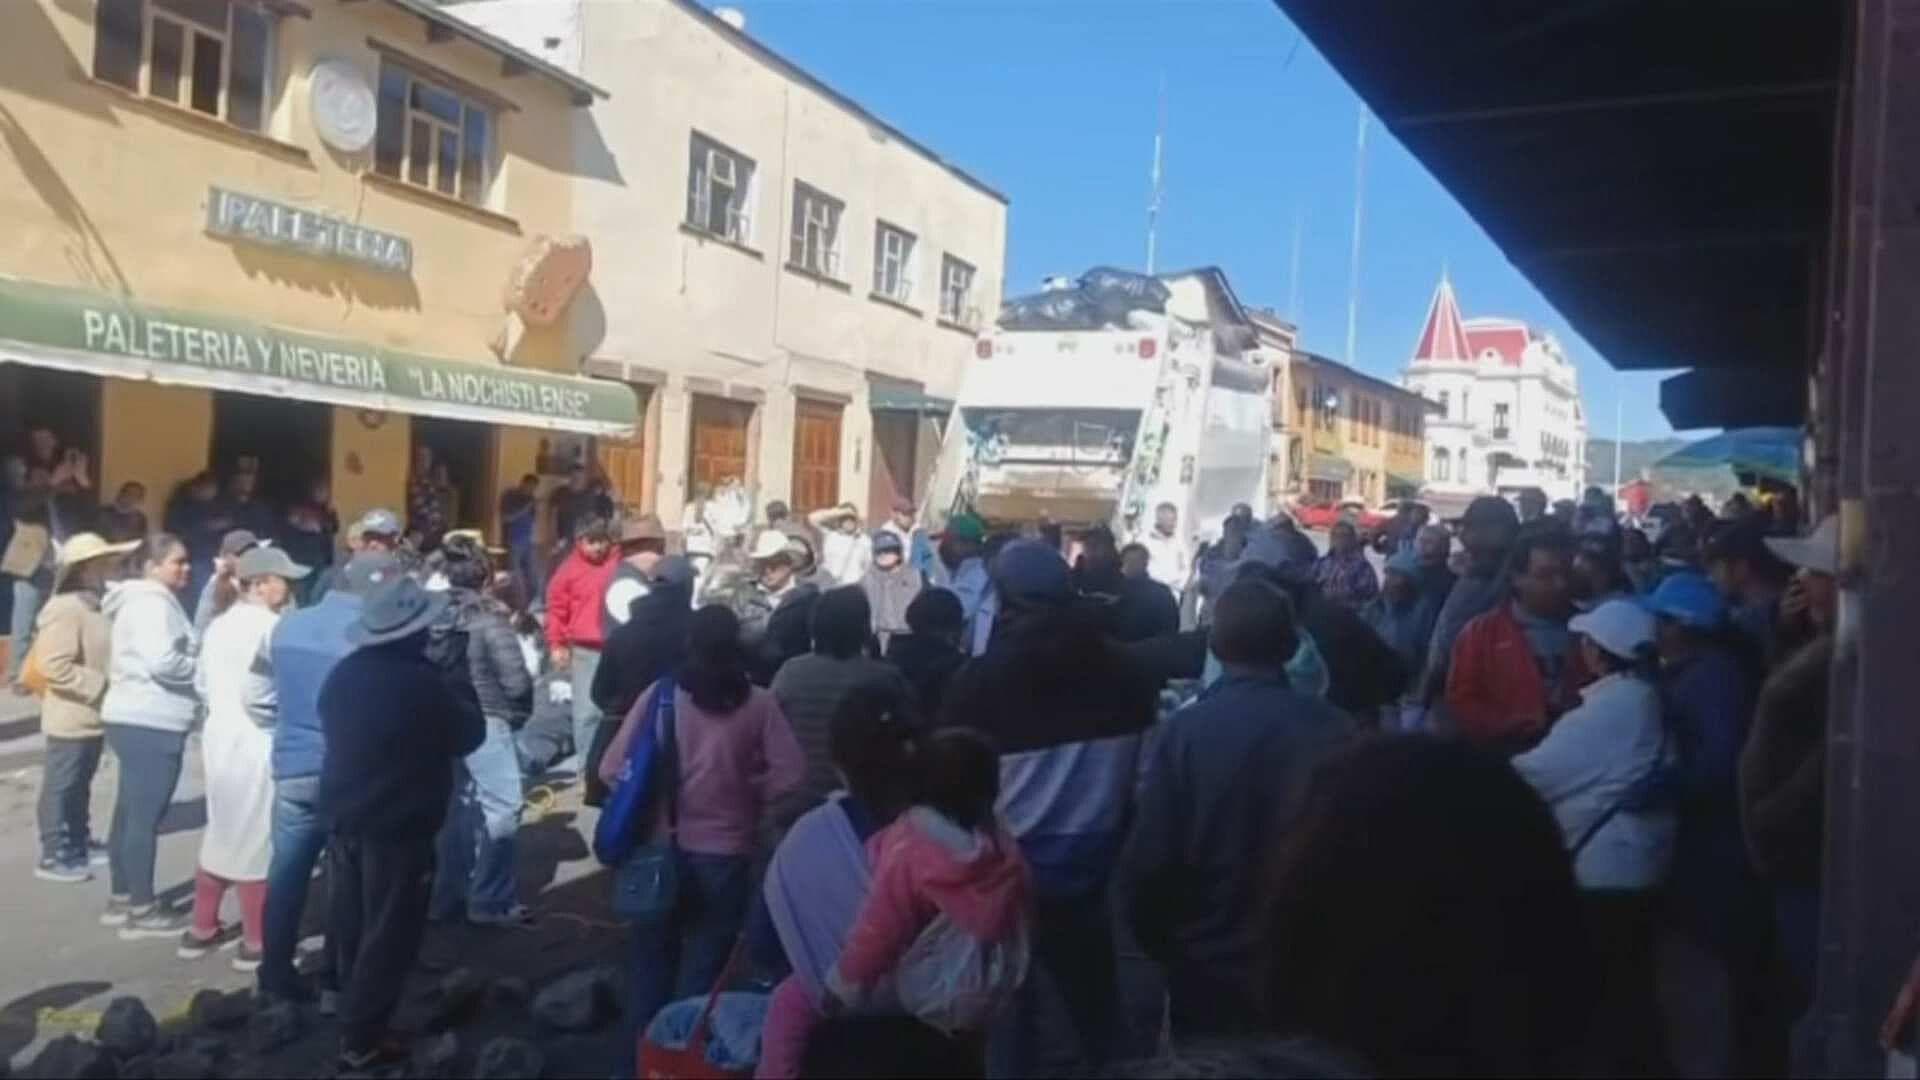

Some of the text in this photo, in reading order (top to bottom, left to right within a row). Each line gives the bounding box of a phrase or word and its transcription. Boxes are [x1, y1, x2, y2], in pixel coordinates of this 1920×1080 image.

[84, 309, 250, 368] PALETERIA
[256, 338, 273, 371] Y
[279, 343, 387, 389] NEVERIA
